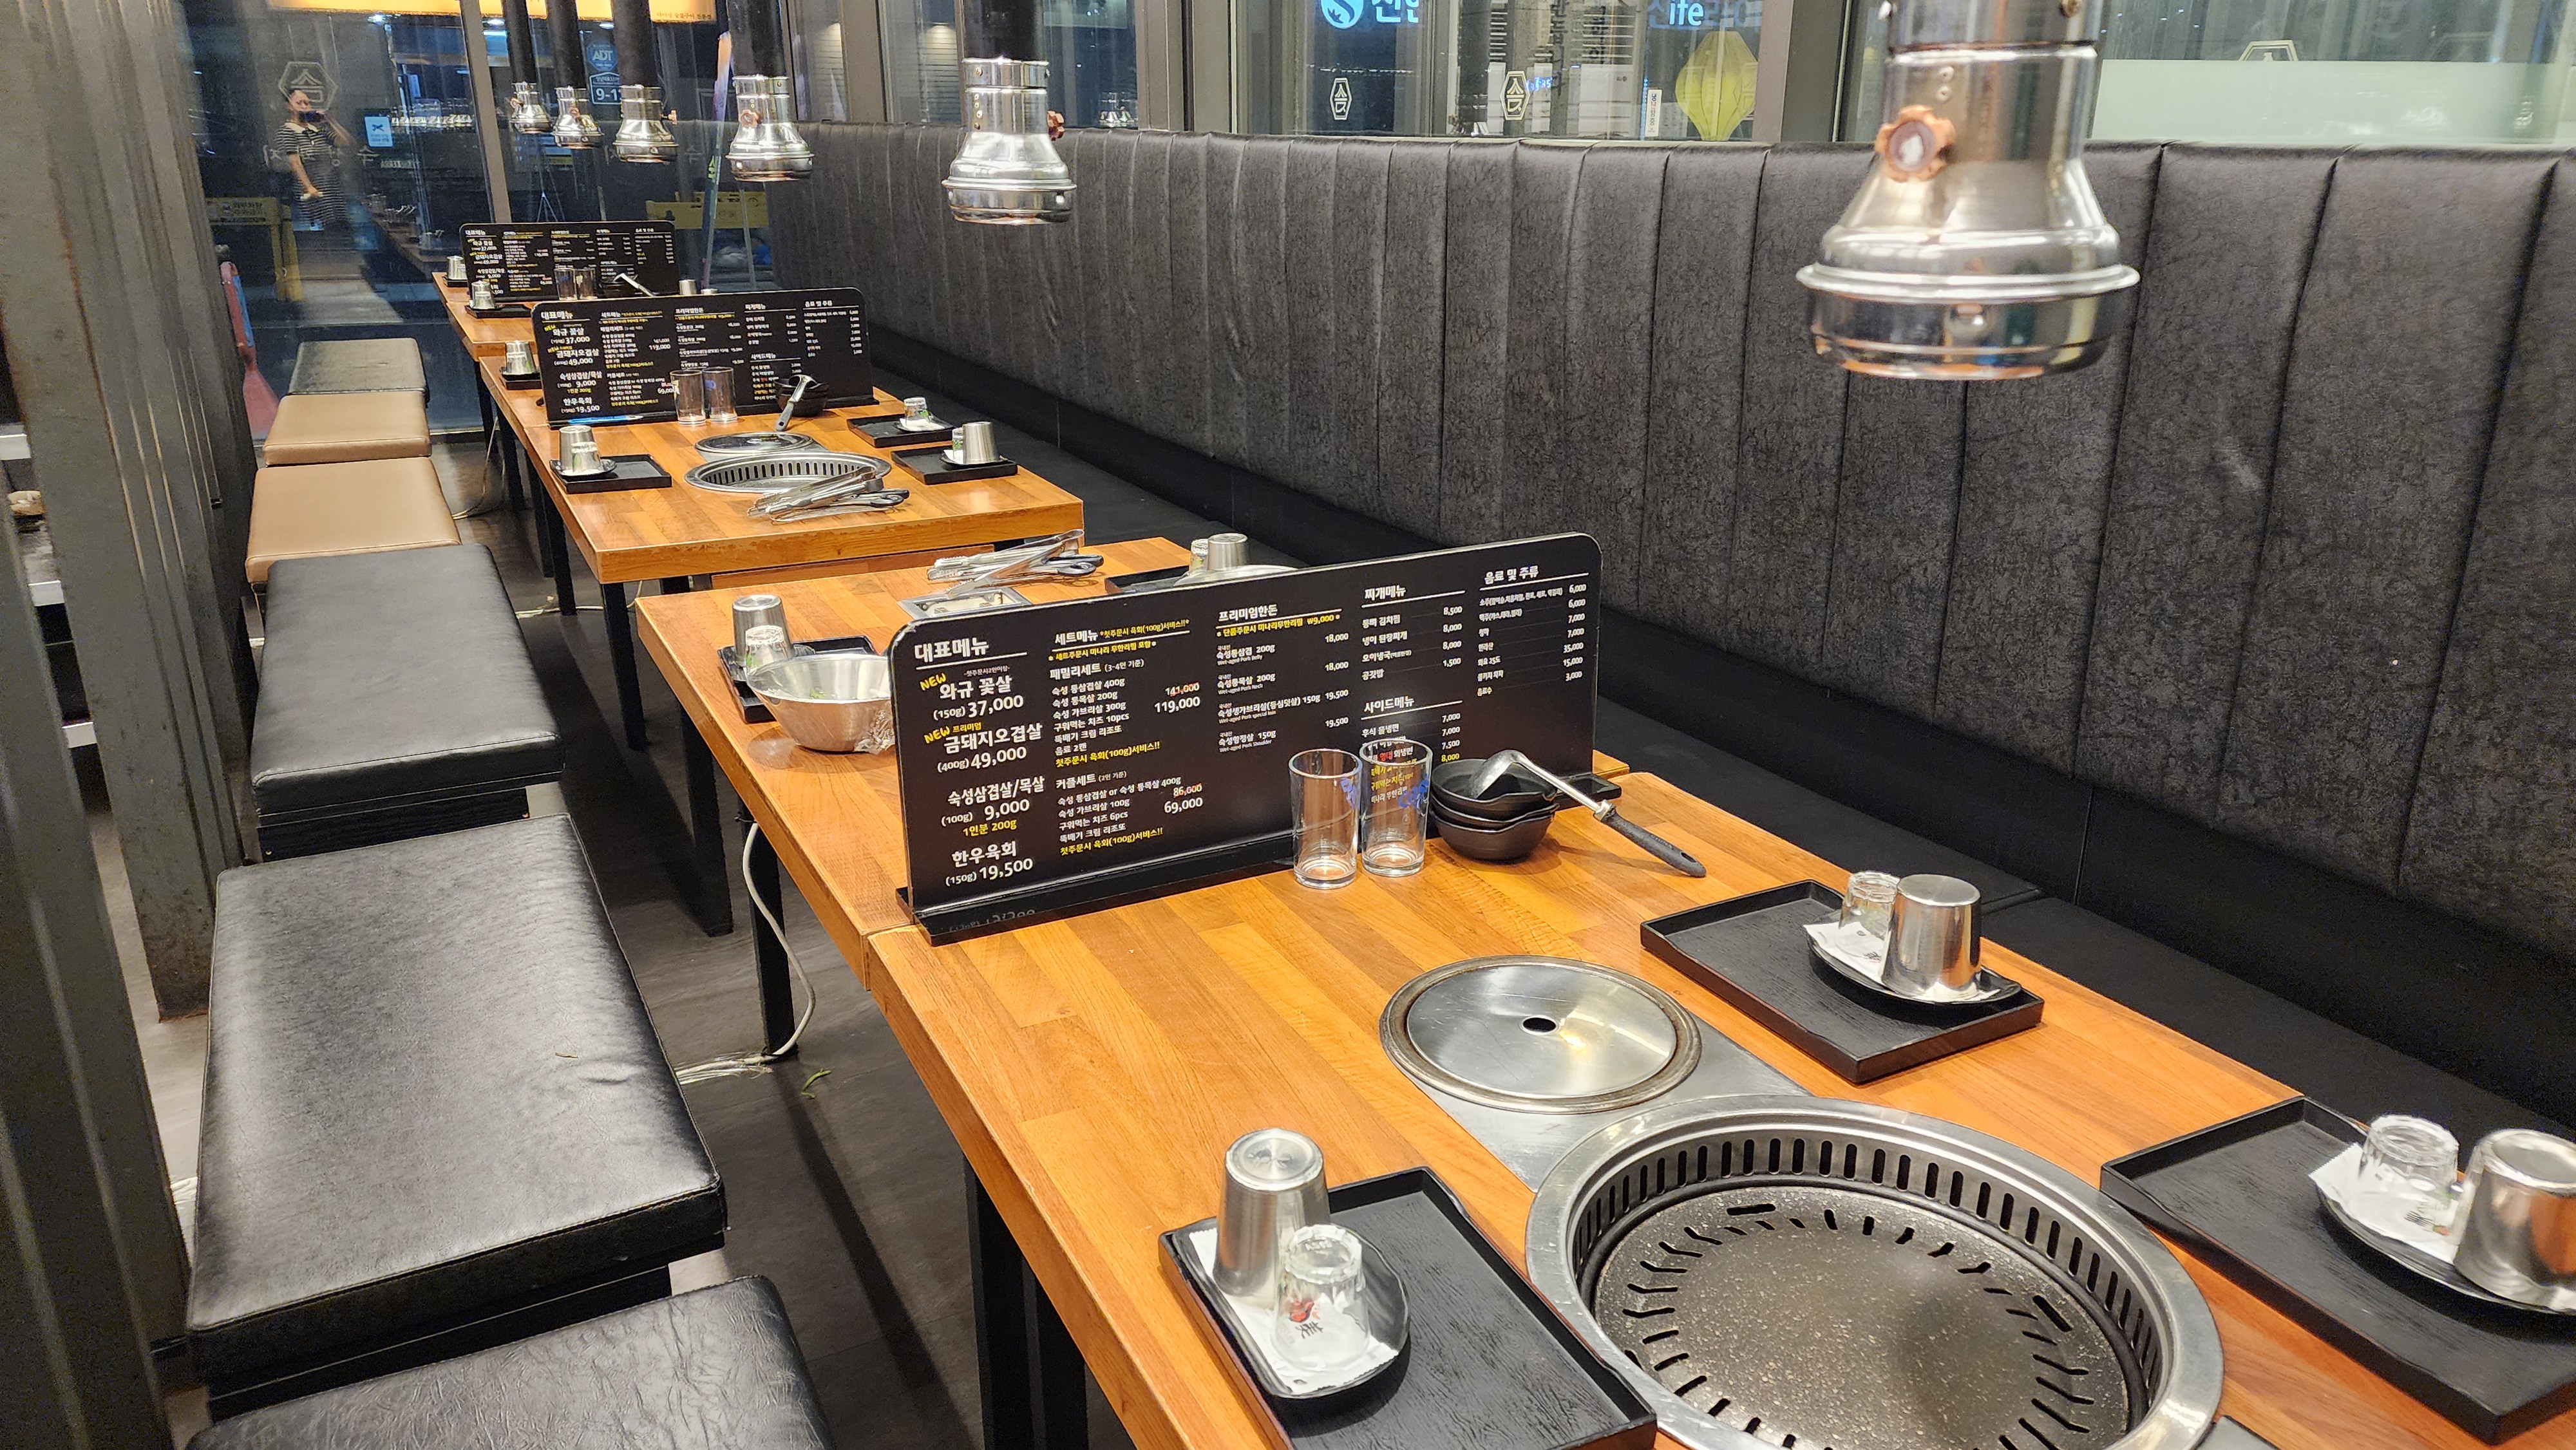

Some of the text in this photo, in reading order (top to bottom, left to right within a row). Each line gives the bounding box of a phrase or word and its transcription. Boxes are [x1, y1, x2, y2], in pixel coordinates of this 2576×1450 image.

[592, 50, 613, 61] ADT
[596, 88, 620, 101] 9-1
[565, 336, 591, 344] 37,000
[569, 358, 593, 366] 49,000
[1484, 565, 1539, 585] 음료 및 주류
[1365, 585, 1406, 601] 찌개메뉴
[1569, 584, 1586, 594] 6,000
[1443, 606, 1463, 616] 8,500
[1568, 599, 1586, 608] 6,000
[1218, 604, 1278, 621] 프리미엄한돈
[1568, 614, 1585, 624] 7,000
[1055, 630, 1098, 645] 세트메뉴
[1362, 623, 1462, 646] 냉이 된장찌개 8,000
[1567, 628, 1584, 638] 7,000
[914, 637, 989, 662] 대표메뉴
[1256, 645, 1275, 654] 200g
[1325, 632, 1349, 643] 18,000
[1443, 641, 1462, 650] 8,000
[1564, 643, 1584, 654] 35,000
[1362, 657, 1461, 681] 공깃밥 1,500
[1563, 657, 1583, 668] 15,000
[1050, 663, 1101, 681] 패밀리세트
[1257, 673, 1276, 683] 200g
[1325, 661, 1349, 672] 18,000
[1566, 672, 1582, 682] 3,000
[920, 673, 947, 691] NEW
[940, 675, 1012, 700] 와규 꽃살
[1052, 678, 1125, 696] 숙성 통삼겹살 400g
[1052, 692, 1118, 708] 숙성 통목살 200g
[1155, 696, 1200, 713] 119,000
[1302, 694, 1321, 704] 150g
[1325, 689, 1349, 701] 19,500
[1364, 696, 1414, 713] 사이드메뉴
[934, 695, 1023, 720] (150g) 37,000
[1053, 702, 1126, 720] 숙성 가브리살 300g
[1054, 713, 1129, 732] 구워먹는 치즈 10pcs
[1258, 730, 1276, 740] 150g
[1325, 717, 1349, 728] 19,500
[1361, 728, 1376, 738] 후식
[1442, 713, 1461, 723] 7,000
[924, 722, 981, 744] NEW 프리미엄
[944, 722, 1043, 754] 금돼지오겹살
[1054, 725, 1122, 744] 뚝배기 크림 리조또
[1442, 726, 1461, 737] 7,000
[1055, 742, 1087, 756] 음료 2캔
[1442, 740, 1460, 750] 7,500
[938, 746, 1027, 773] (400g) 49,000
[1056, 754, 1087, 768] 첫주문시
[1441, 753, 1460, 763] 8,000
[1056, 773, 1096, 790] 커플세트
[948, 776, 1045, 807] 숙성삼겹살/목살
[1058, 796, 1074, 806] 숙성
[1075, 789, 1107, 803] 통삼겹살
[1119, 784, 1135, 794] 숙성
[1137, 780, 1159, 791] 통목살
[1161, 776, 1181, 787] 400g
[942, 799, 1030, 827] (100g) 9,000
[1058, 798, 1130, 818] 숙성 가브리살 100g
[1164, 797, 1203, 814] 69,000
[963, 819, 1017, 836] 1인분 200g
[1059, 811, 1128, 831] 구워먹는 치즈 6pcs
[1103, 823, 1126, 834] 리조또
[951, 841, 1016, 867] 한우육회
[1060, 842, 1092, 856] 첫주문시
[945, 858, 1033, 887] (150g) 19,500
